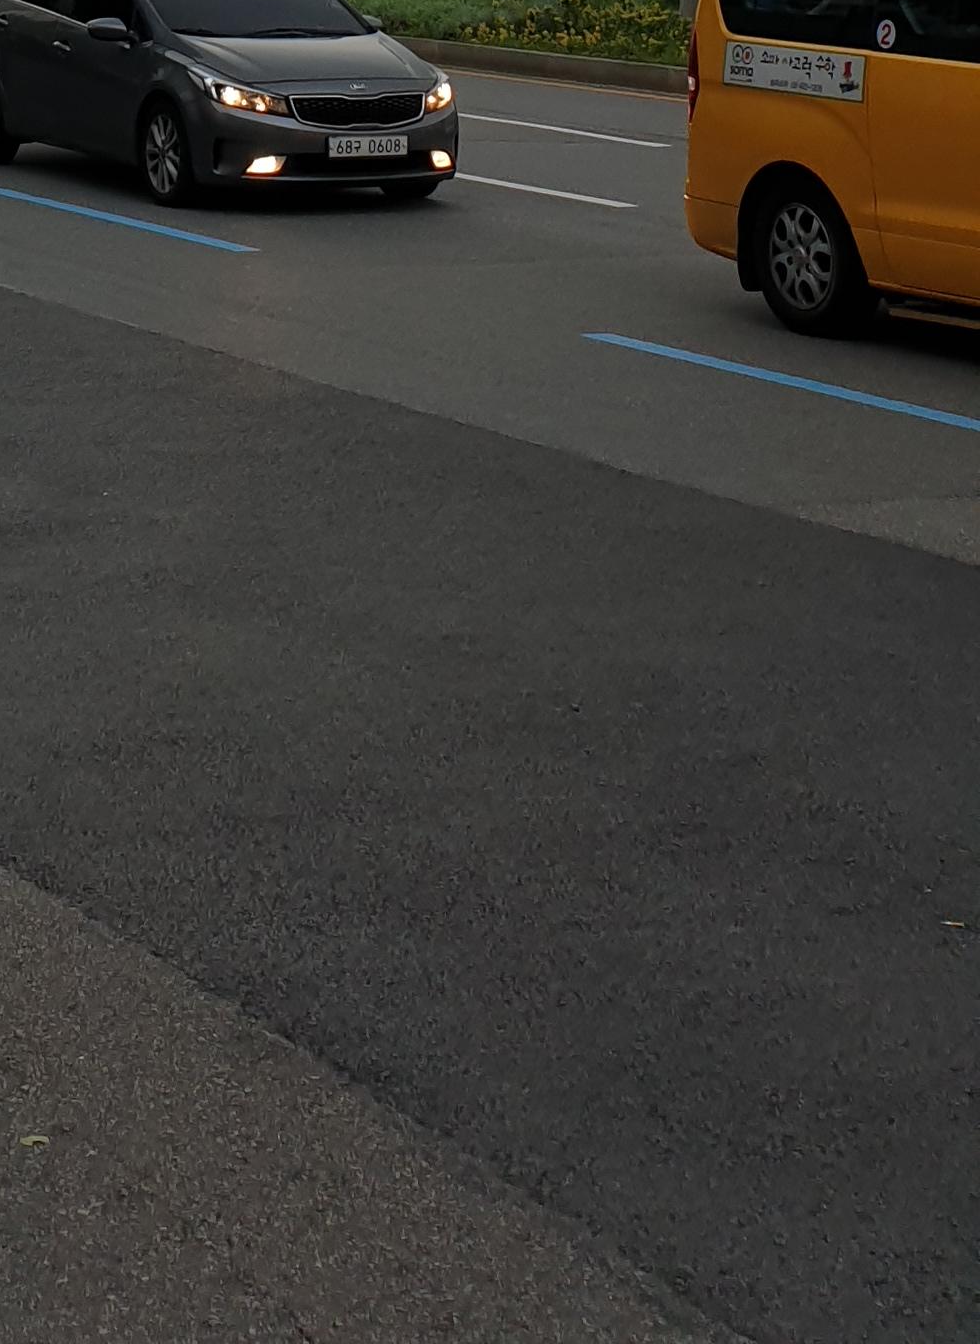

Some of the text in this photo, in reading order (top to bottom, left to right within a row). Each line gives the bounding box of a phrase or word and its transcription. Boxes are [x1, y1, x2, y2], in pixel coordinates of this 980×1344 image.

[815, 55, 836, 80] 수학
[336, 138, 402, 155] 68구 0608
